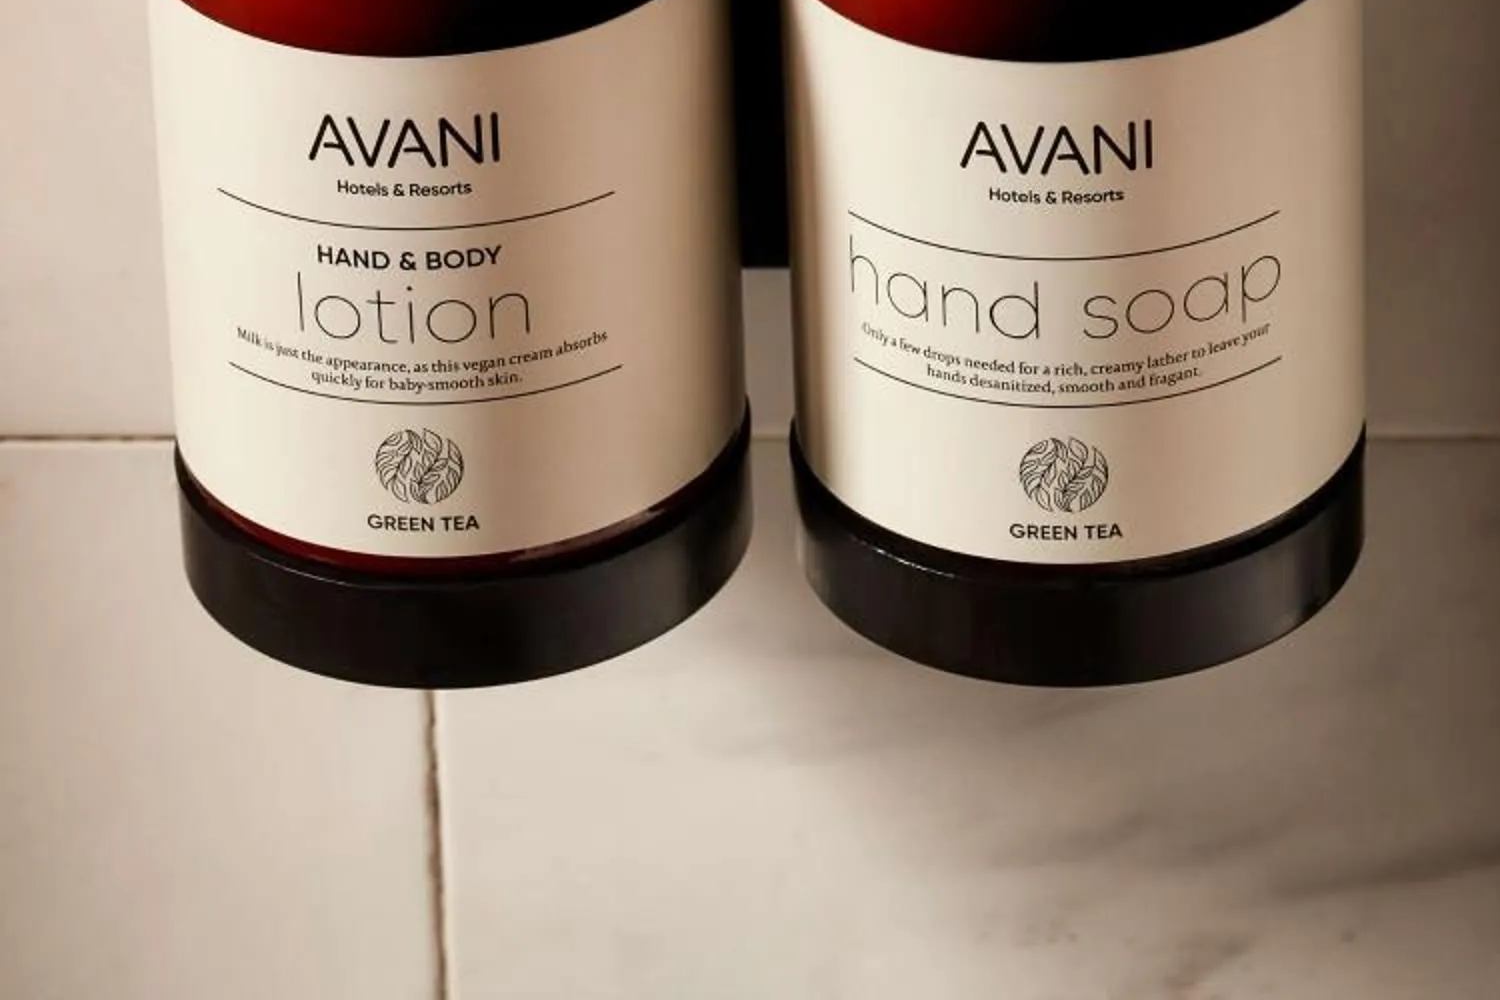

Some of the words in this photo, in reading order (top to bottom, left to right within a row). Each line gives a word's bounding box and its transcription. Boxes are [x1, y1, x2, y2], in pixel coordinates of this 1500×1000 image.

[309, 112, 501, 168] AVANI
[960, 119, 1152, 176] AVANI
[337, 179, 389, 197] Hotels
[393, 183, 405, 197] &
[409, 181, 473, 197] Resorts
[989, 187, 1041, 204] Hotels
[1045, 191, 1057, 205] &
[1061, 189, 1125, 204] Resorts
[317, 244, 390, 270] HAND
[399, 251, 417, 271] &
[426, 244, 502, 270] BODY
[849, 233, 1041, 340] hand
[1082, 254, 1282, 341] soap
[297, 271, 531, 344] lotion
[237, 325, 262, 347] Milk
[264, 340, 275, 351] is
[275, 344, 298, 357] just
[301, 349, 323, 365] the
[325, 356, 411, 374] appearance,
[413, 363, 429, 373] as
[431, 359, 460, 373] this
[463, 356, 506, 374] vegan
[508, 347, 553, 366] cream
[555, 331, 609, 357] absorbs
[861, 321, 890, 347] Only
[890, 338, 897, 347] a
[899, 336, 921, 354] few
[924, 346, 960, 367] drops
[964, 357, 1015, 374] needed
[1018, 361, 1039, 376] for
[1043, 366, 1051, 375] a
[1054, 363, 1088, 377] rich,
[1090, 358, 1144, 375] creamy
[1147, 351, 1189, 369] lather
[1191, 346, 1206, 359] to
[1208, 337, 1242, 355] leave
[1241, 323, 1271, 346] your
[311, 370, 362, 391] quickly
[364, 372, 384, 389] for
[389, 374, 485, 394] baby-smooth
[487, 371, 523, 387] skin.
[926, 364, 967, 384] hands
[969, 374, 1056, 395] desanitized,
[1058, 378, 1115, 393] smooth
[1118, 376, 1145, 391] and
[367, 514, 435, 532] GREEN
[440, 515, 480, 532] TEA
[1009, 523, 1078, 541] GREEN
[1084, 522, 1123, 540] TEA
